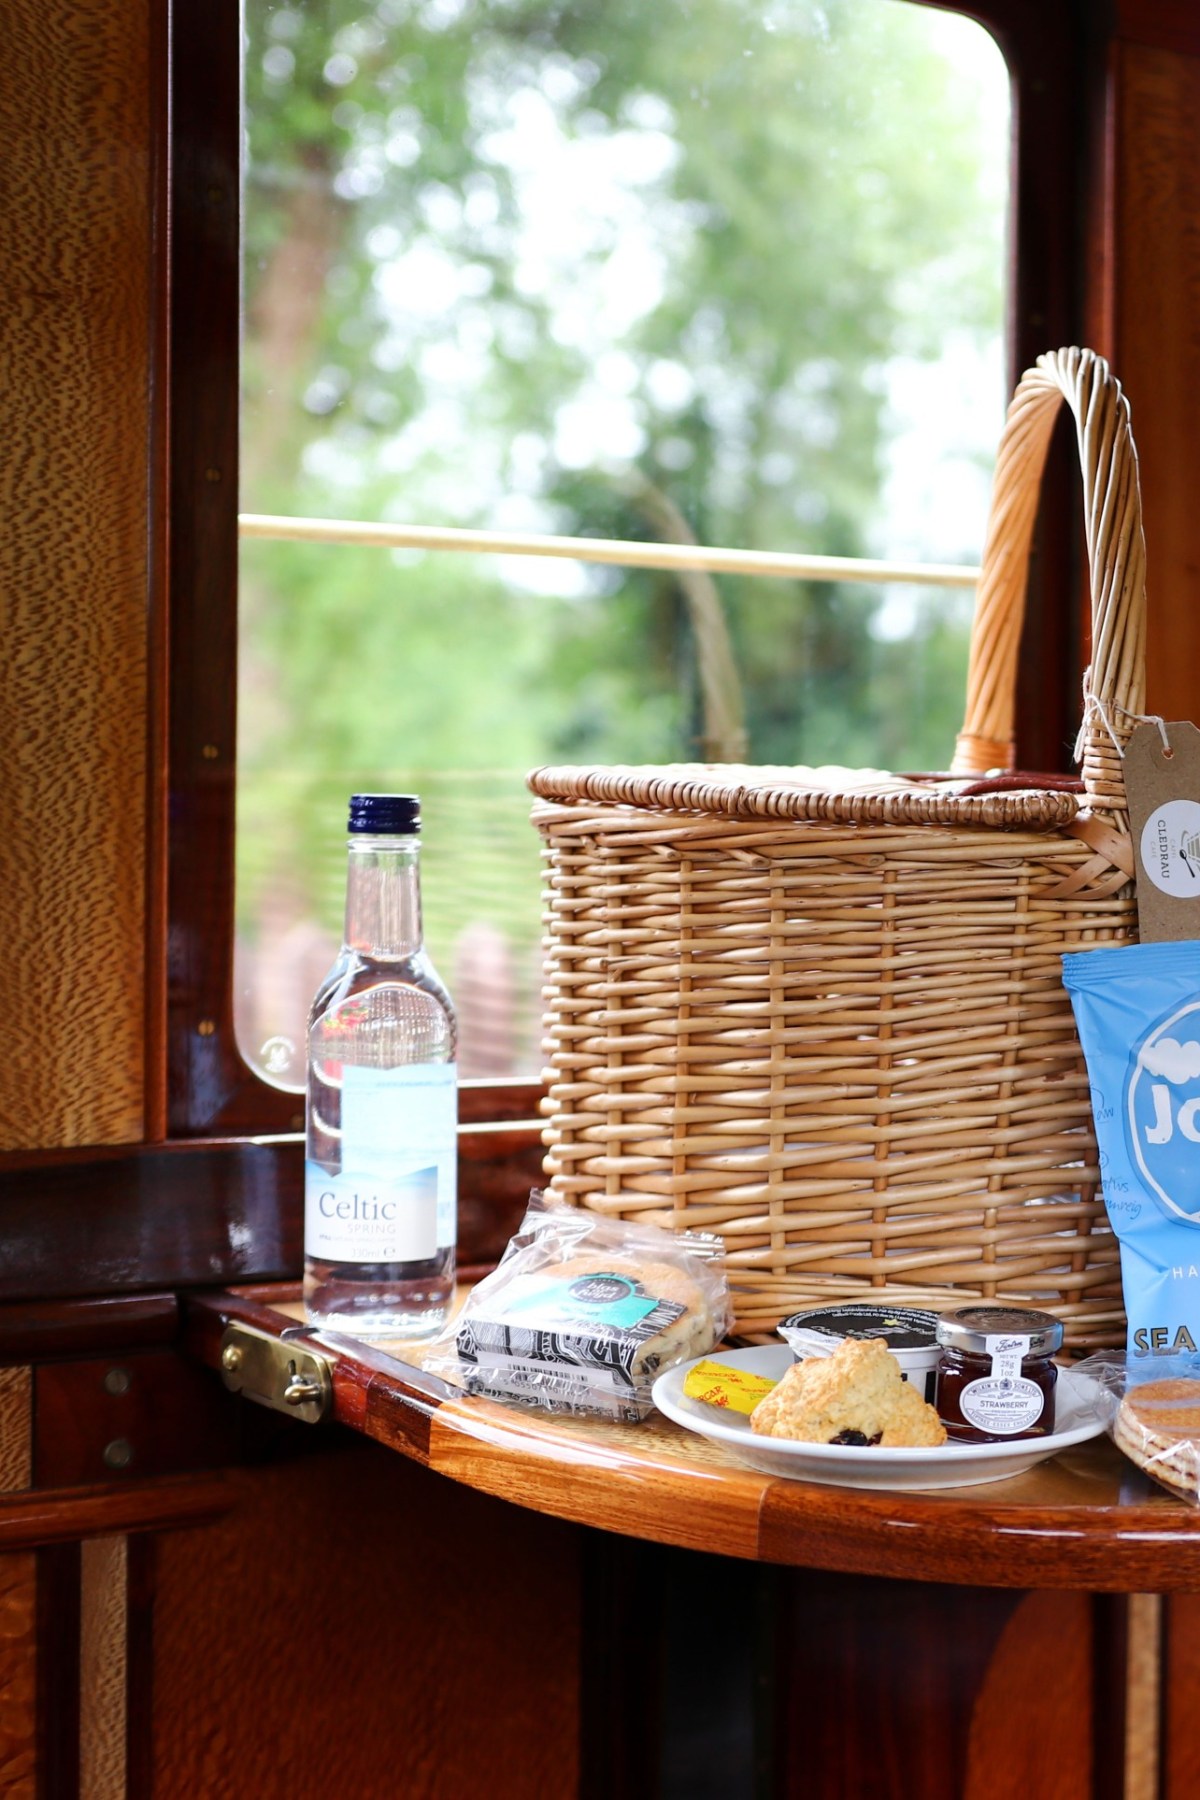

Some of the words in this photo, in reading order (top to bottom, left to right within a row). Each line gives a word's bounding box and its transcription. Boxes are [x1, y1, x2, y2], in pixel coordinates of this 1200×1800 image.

[1157, 819, 1170, 879] CLEDRAU
[319, 1192, 396, 1220] Celtic
[347, 1223, 396, 1234] SPRING
[351, 1247, 380, 1258] 330ml
[1133, 1325, 1198, 1357] SEA
[1000, 1360, 1015, 1369] 28g
[980, 1400, 1028, 1409] STRAWBERRY
